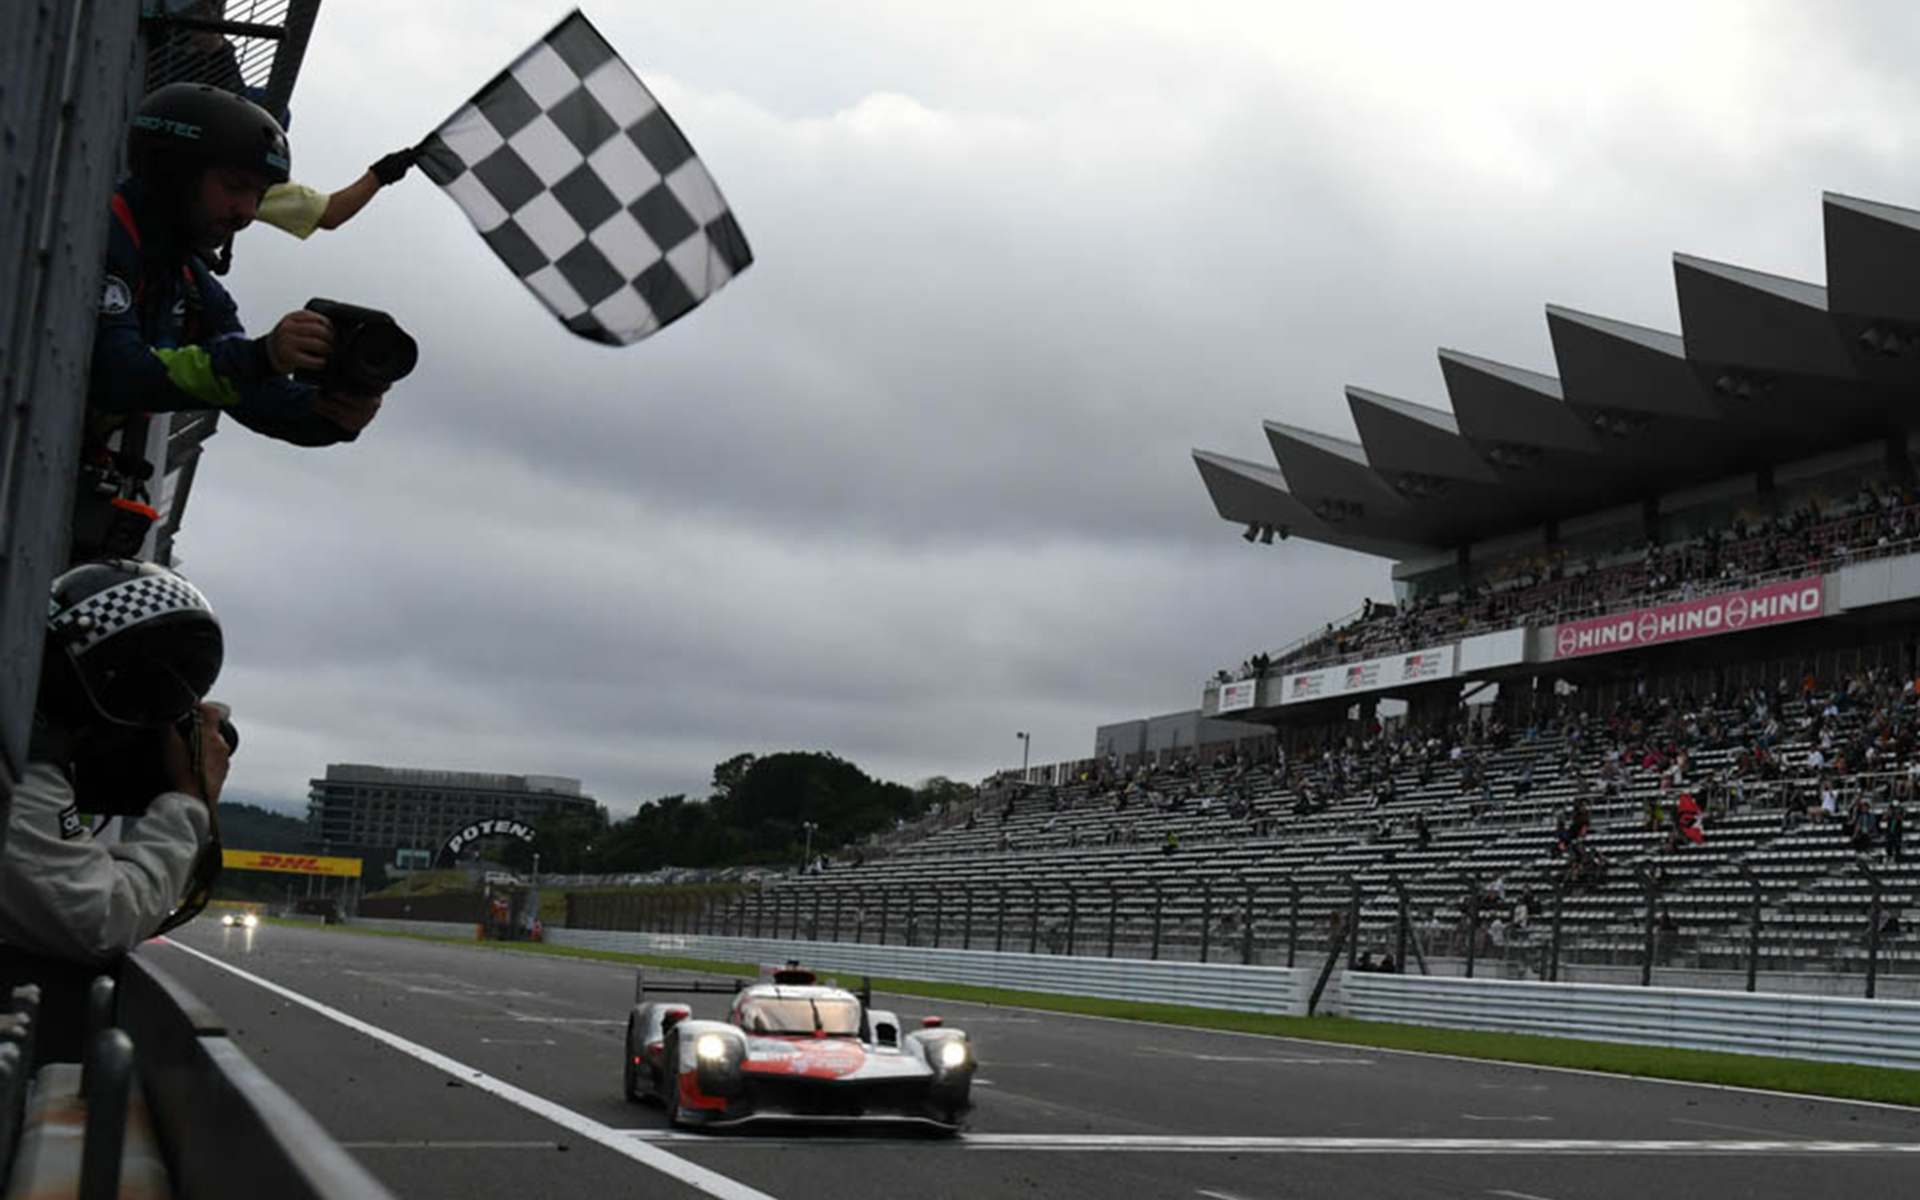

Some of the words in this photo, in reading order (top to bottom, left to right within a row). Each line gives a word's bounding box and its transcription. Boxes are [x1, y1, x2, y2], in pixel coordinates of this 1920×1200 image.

[1578, 621, 1634, 649] HINO
[1660, 605, 1722, 635] HINO
[1750, 588, 1820, 619] HINO
[258, 854, 319, 871] DHL
